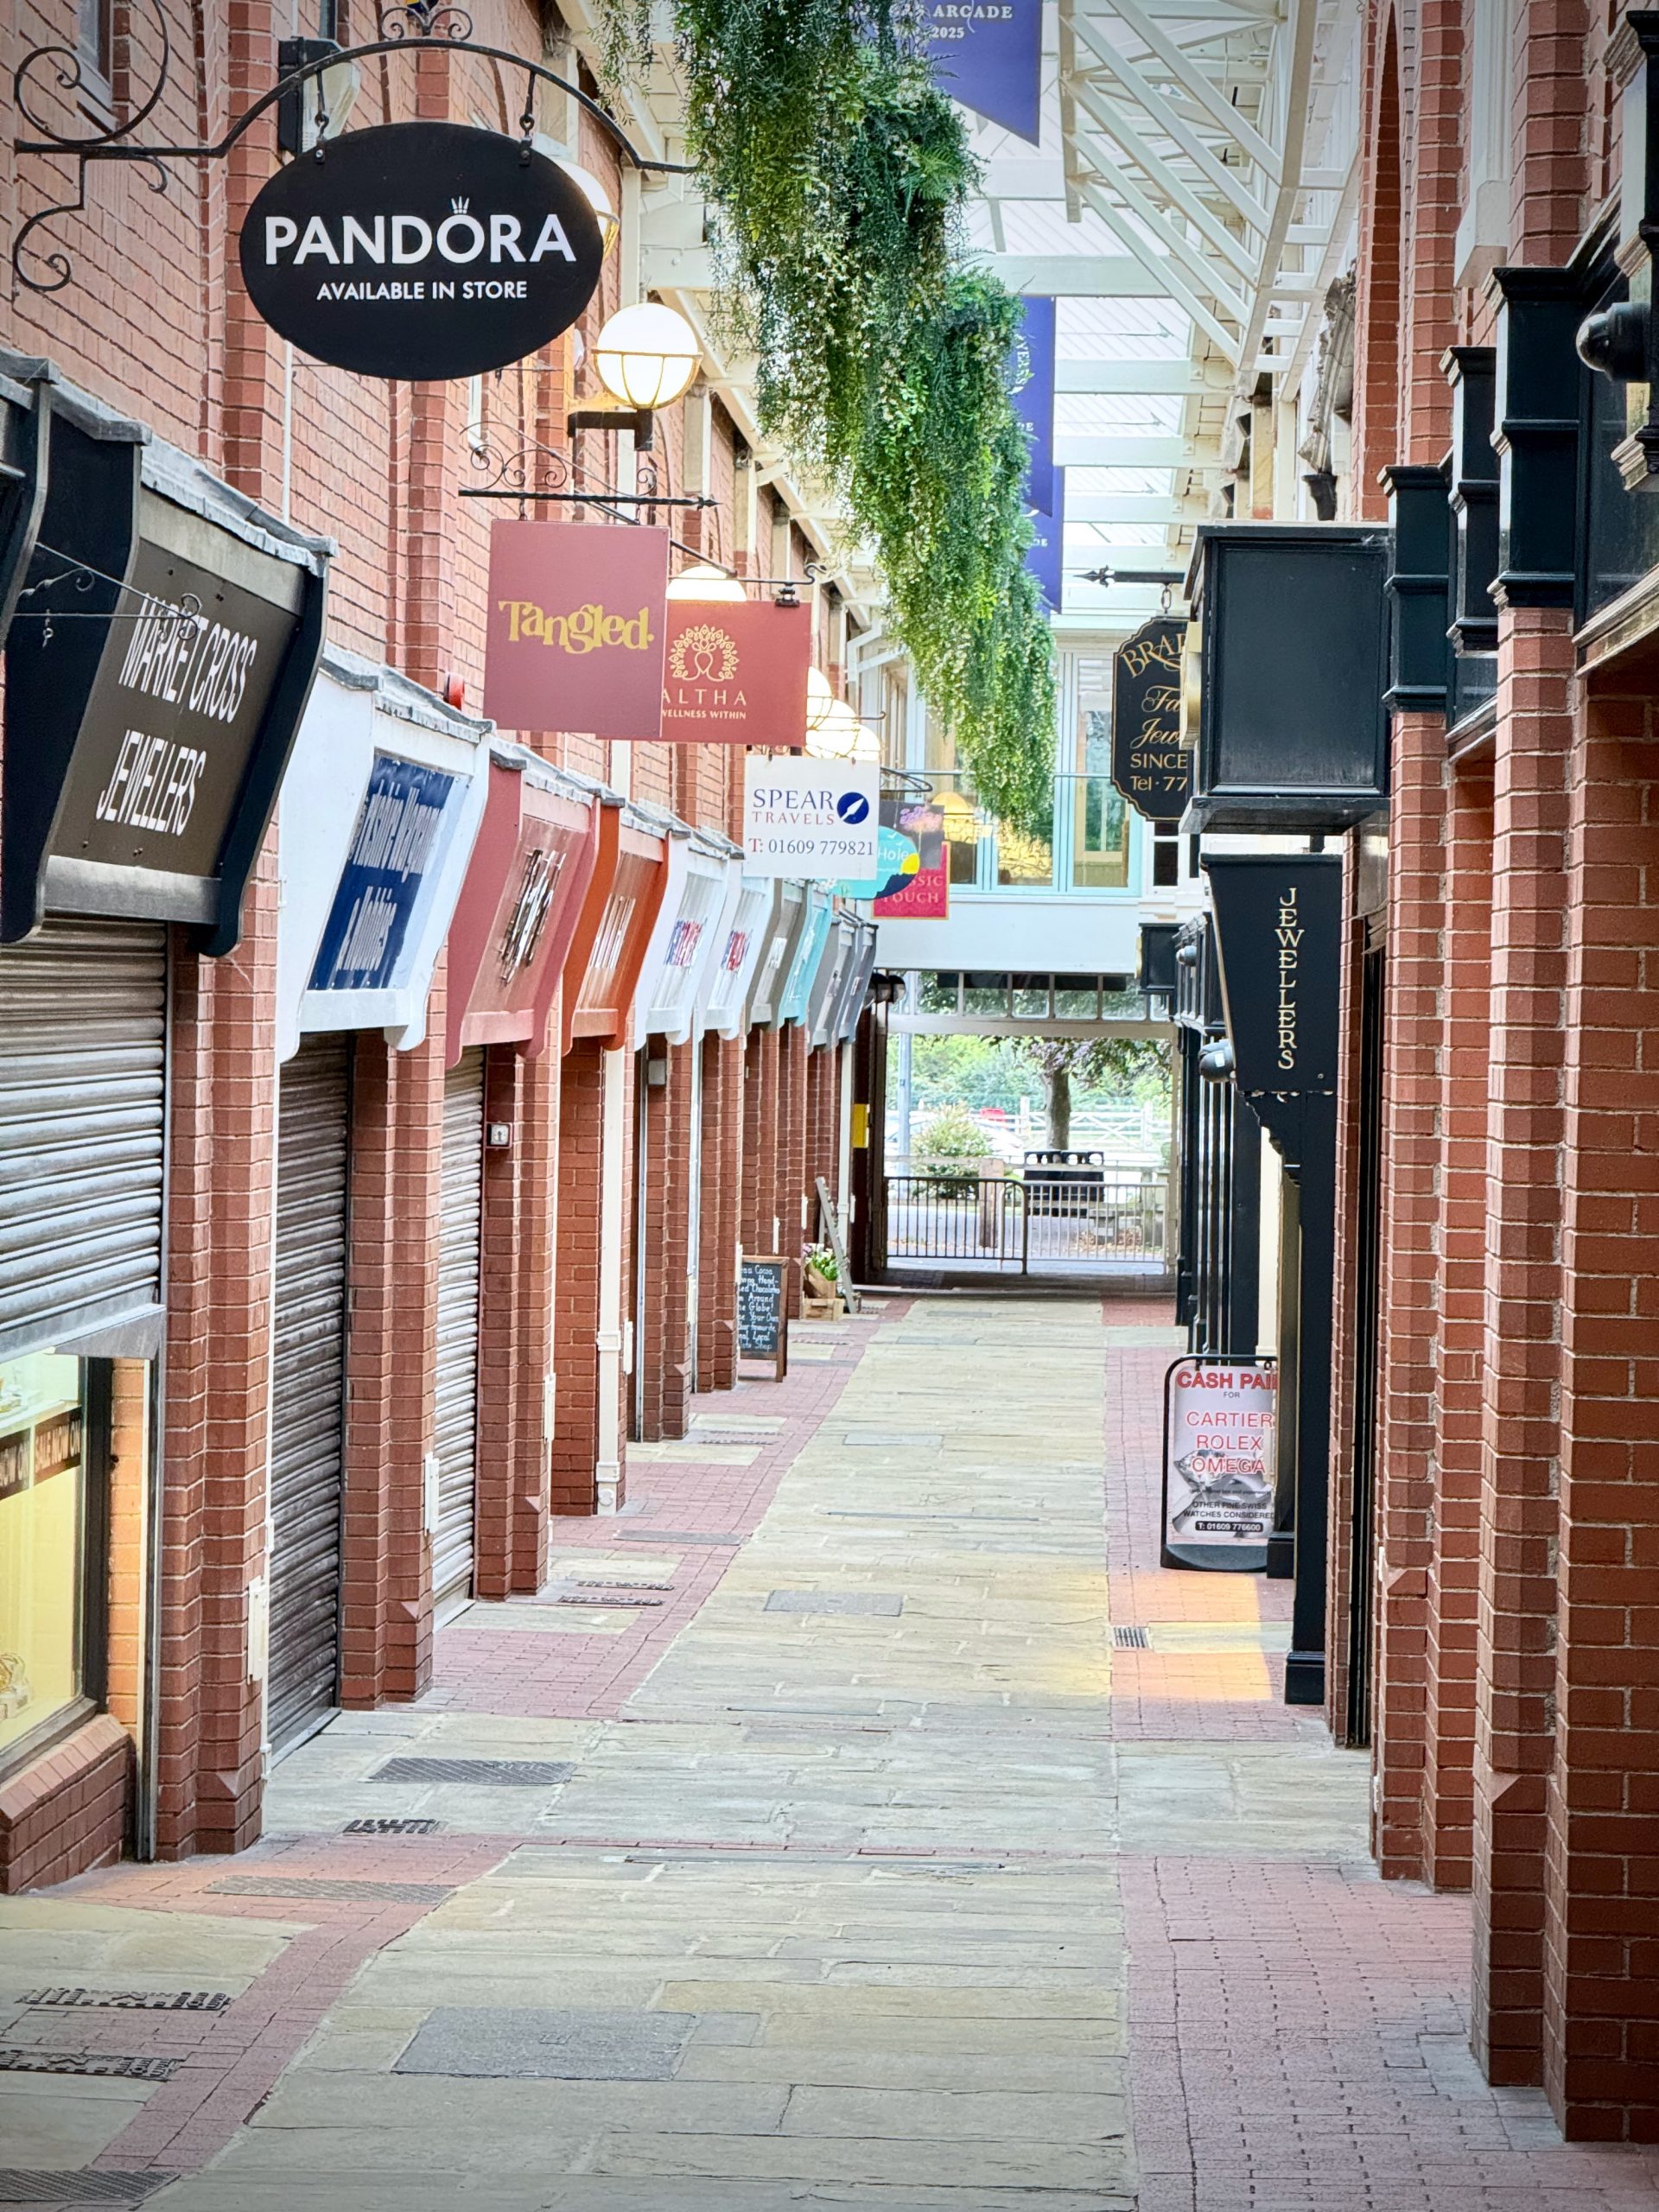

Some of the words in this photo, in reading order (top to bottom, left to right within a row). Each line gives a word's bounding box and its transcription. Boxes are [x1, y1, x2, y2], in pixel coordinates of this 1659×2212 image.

[933, 4, 1013, 19] ARCADE
[931, 27, 965, 38] 2025
[264, 213, 577, 264] PANDORA
[316, 282, 424, 301] AVAILABLE
[432, 281, 454, 299] IN
[462, 281, 527, 299] STORE
[118, 593, 209, 704] MARKET
[189, 622, 257, 724] CROSS
[661, 688, 747, 706] ALTHA
[709, 710, 747, 720] WITHIN
[1130, 753, 1187, 769] SINCE
[96, 729, 207, 836] JEWELLERS
[753, 788, 834, 810] SPEAR
[752, 811, 835, 825] TRAVELS
[748, 838, 763, 853] T:
[768, 839, 815, 854] 01609
[820, 841, 874, 855] 779821
[1274, 887, 1305, 1070] JEWELLERS
[1177, 1371, 1233, 1389] CASH
[1186, 1411, 1274, 1428] CARTIER
[1197, 1434, 1263, 1451] ROLEX
[1192, 1458, 1266, 1474] OMEGA
